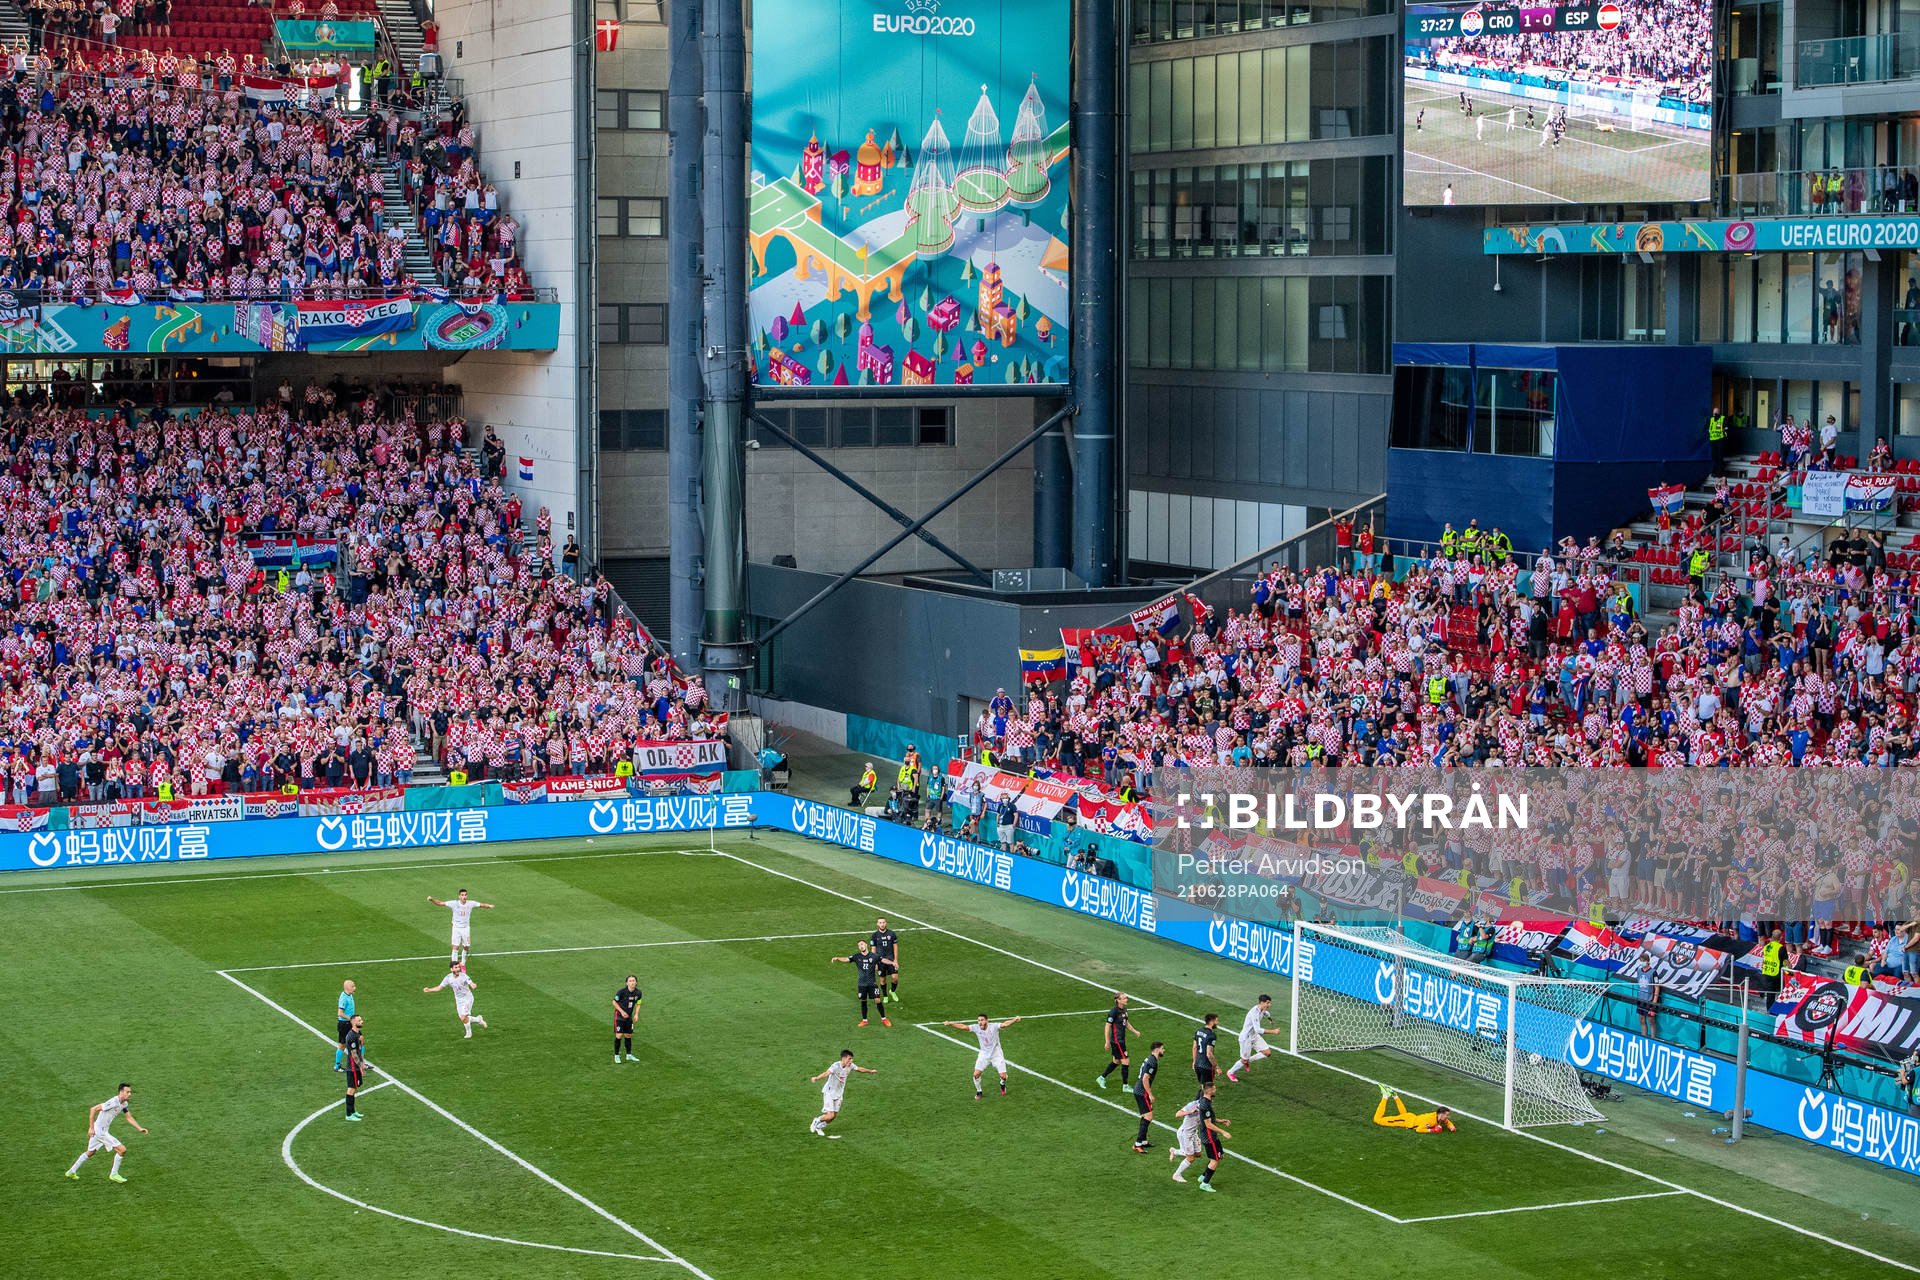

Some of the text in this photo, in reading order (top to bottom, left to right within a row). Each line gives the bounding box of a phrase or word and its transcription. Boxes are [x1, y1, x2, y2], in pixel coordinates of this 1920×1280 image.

[873, 14, 975, 36] EURO2020
[1420, 18, 1454, 32] 37:27
[1489, 15, 1513, 29] CRO
[1565, 12, 1589, 25] ESP
[1781, 222, 1919, 247] UEFA EURO 2020
[189, 807, 239, 821] HRVATSKA
[351, 808, 488, 848] 蚂蚁财富
[622, 793, 753, 832] 蚂蚁财富
[808, 803, 877, 852] 蚂蚁财富
[66, 824, 210, 865] 蚂蚁财富
[936, 839, 1014, 891] 蚂蚁财富
[1080, 874, 1159, 933] 蚂蚁财富
[1597, 1027, 1716, 1107] 蚂蚁财富
